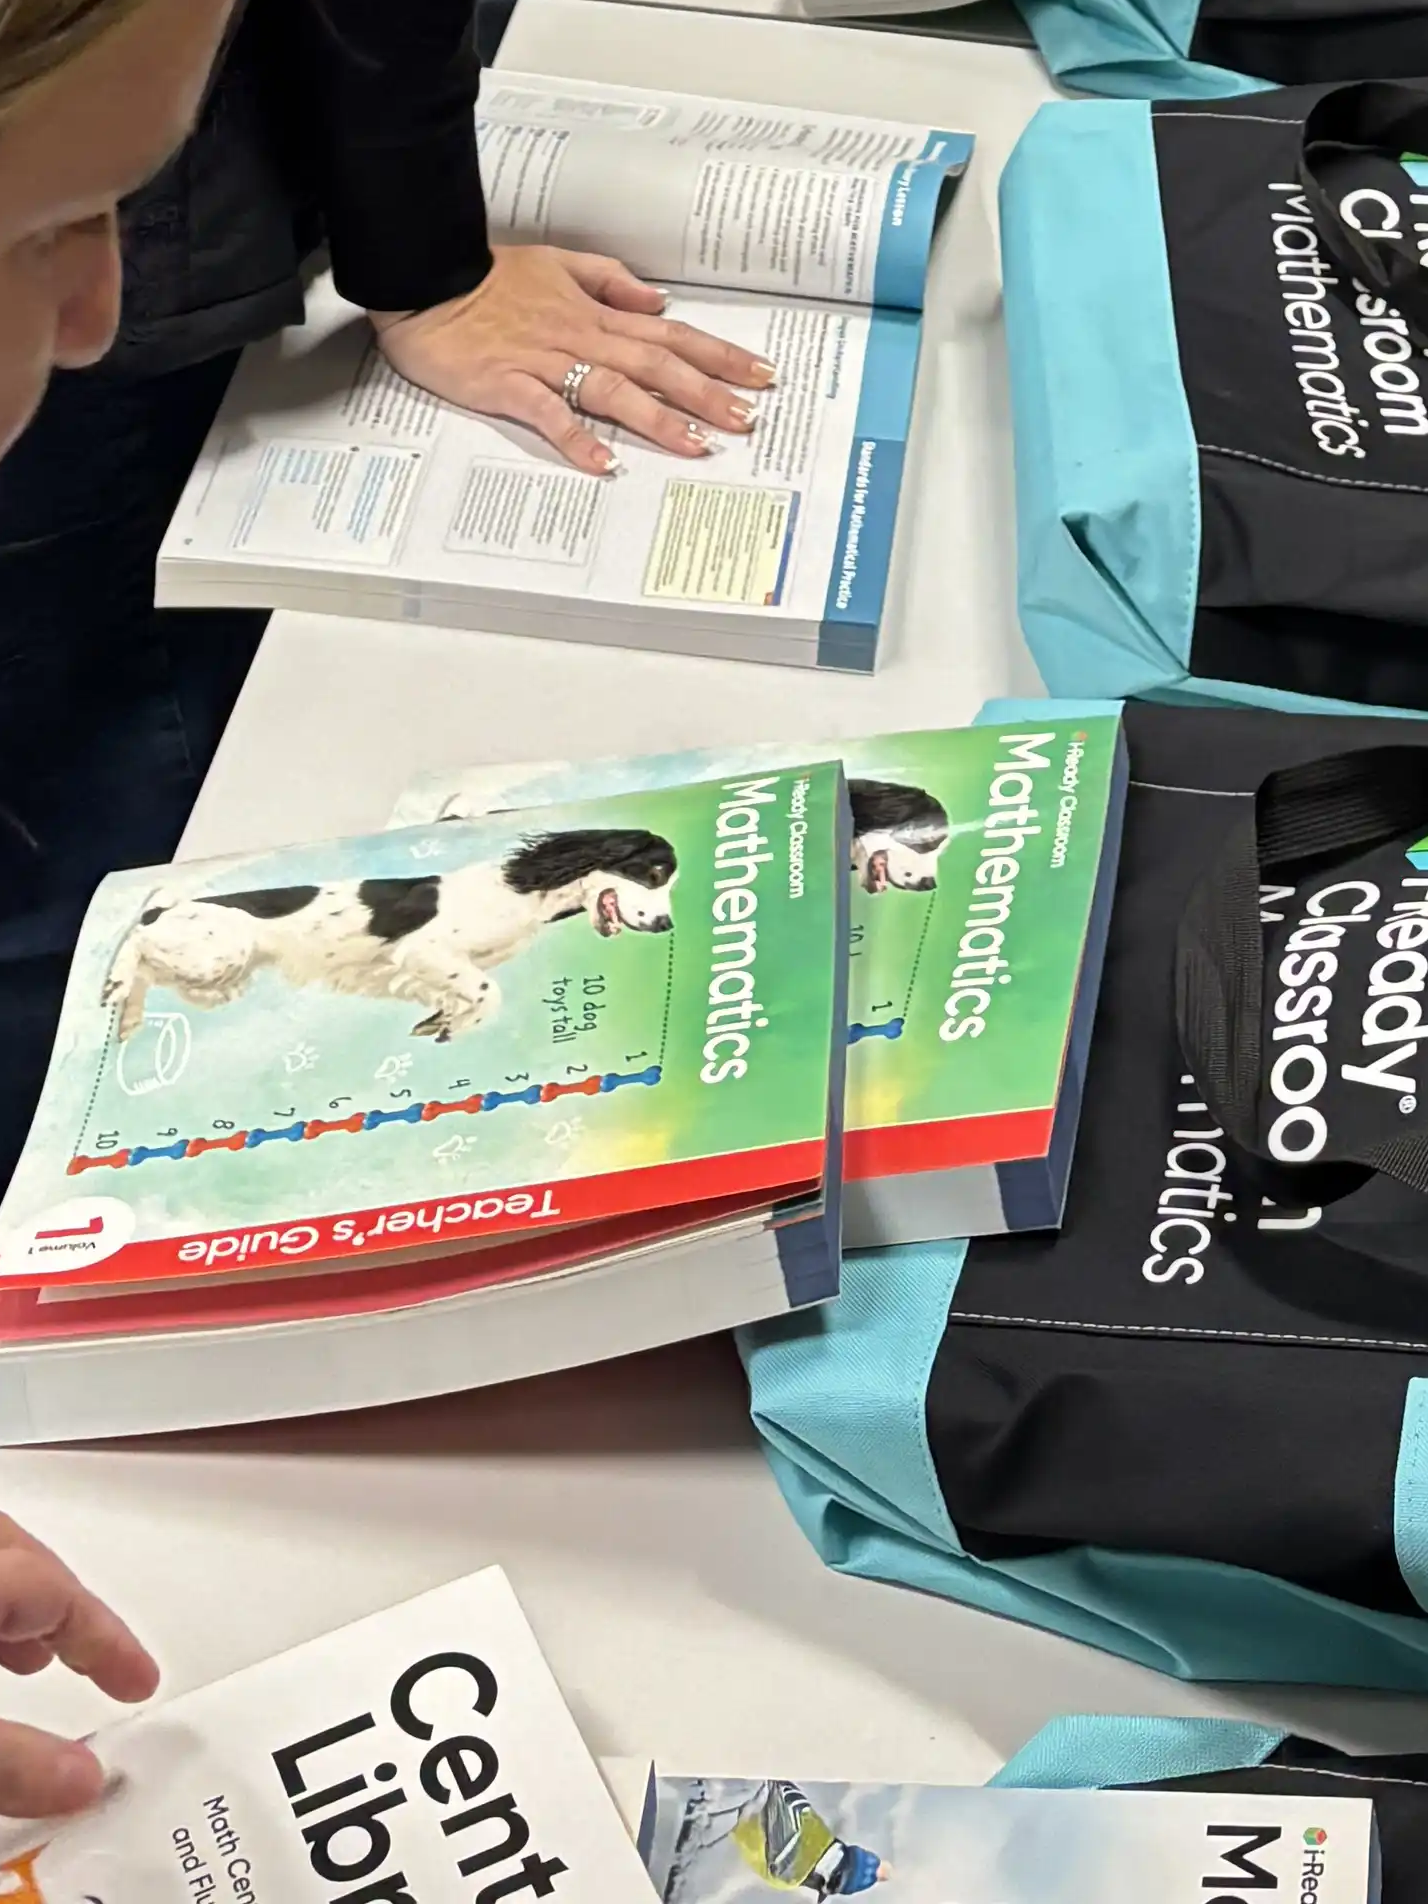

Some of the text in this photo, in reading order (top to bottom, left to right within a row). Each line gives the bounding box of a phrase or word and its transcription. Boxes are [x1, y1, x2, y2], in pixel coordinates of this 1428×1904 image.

[1050, 794, 1079, 868] Classroom
[788, 822, 811, 899] Classroom
[939, 731, 1057, 1043] Mathematics
[700, 775, 781, 1084] Mathematics
[542, 976, 577, 1044] toys tall
[573, 974, 607, 1032] 10 dog
[872, 1000, 893, 1012] 1
[625, 1050, 648, 1063] 1
[505, 1071, 530, 1083] 3
[566, 1063, 588, 1075] 2
[390, 1088, 412, 1100] 5
[448, 1078, 471, 1091] 4
[273, 1106, 296, 1119] 7
[328, 1096, 352, 1109] 6
[156, 1126, 179, 1138] 9
[212, 1118, 235, 1130] 8
[95, 1129, 120, 1150] 10
[34, 1215, 104, 1240] 1
[177, 1189, 562, 1266] Teacher's Guide
[390, 1651, 570, 1904] Cent
[203, 1794, 241, 1857] Math
[172, 1827, 207, 1874] and
